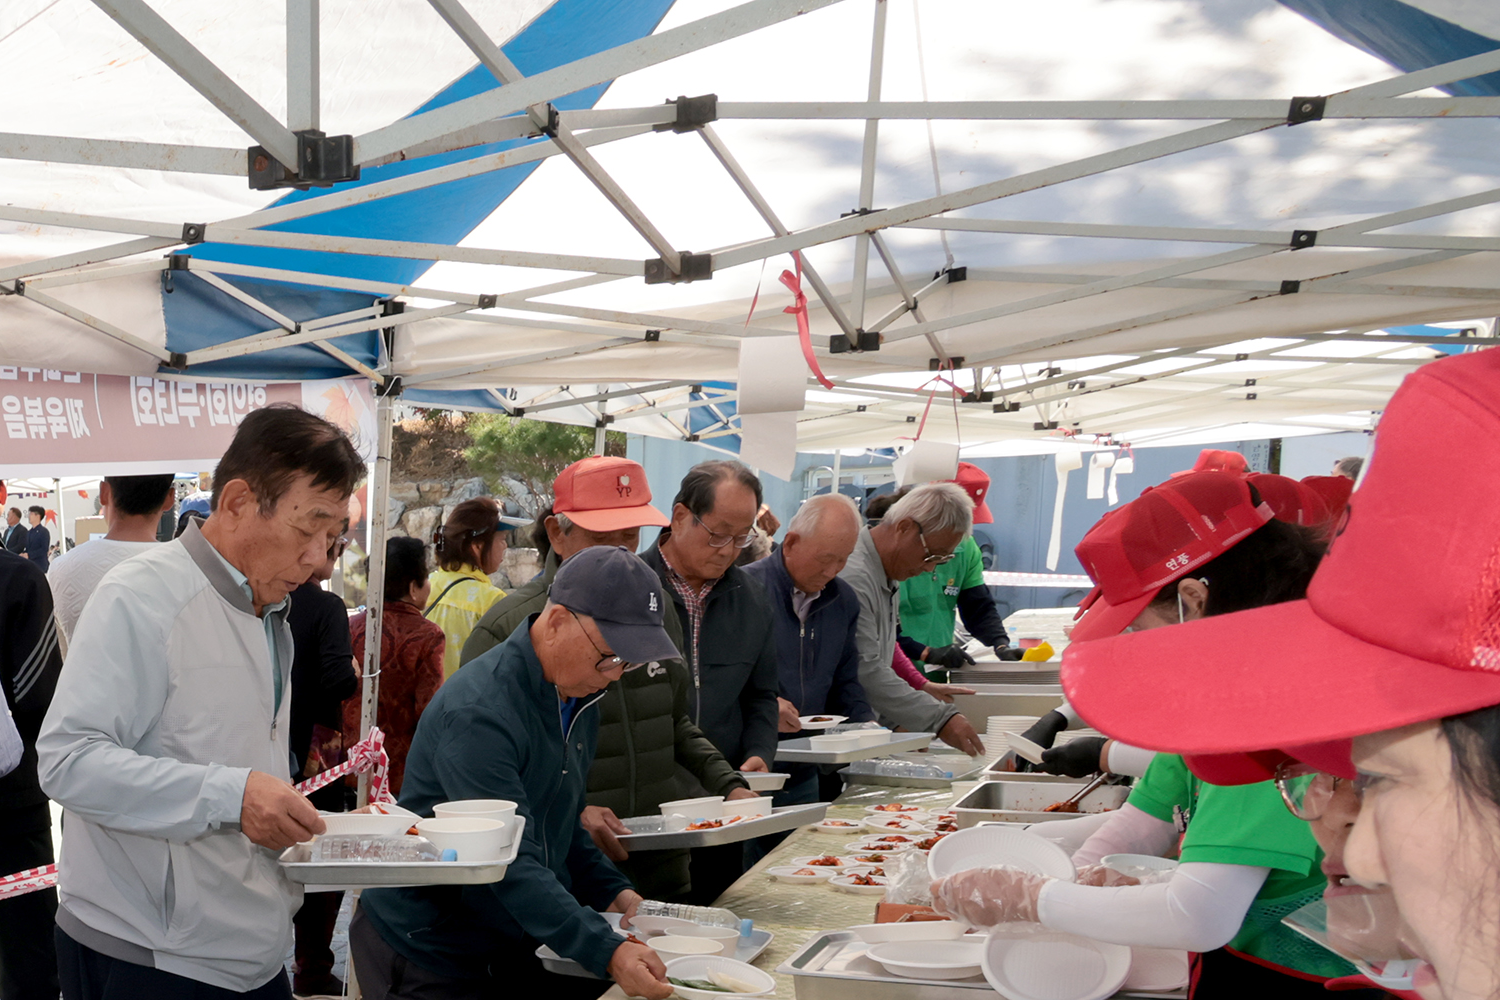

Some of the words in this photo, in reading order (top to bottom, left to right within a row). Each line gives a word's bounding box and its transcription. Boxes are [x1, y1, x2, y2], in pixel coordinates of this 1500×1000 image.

[616, 486, 632, 498] YP
[1165, 552, 1190, 571] 연풍
[648, 592, 658, 611] LA
